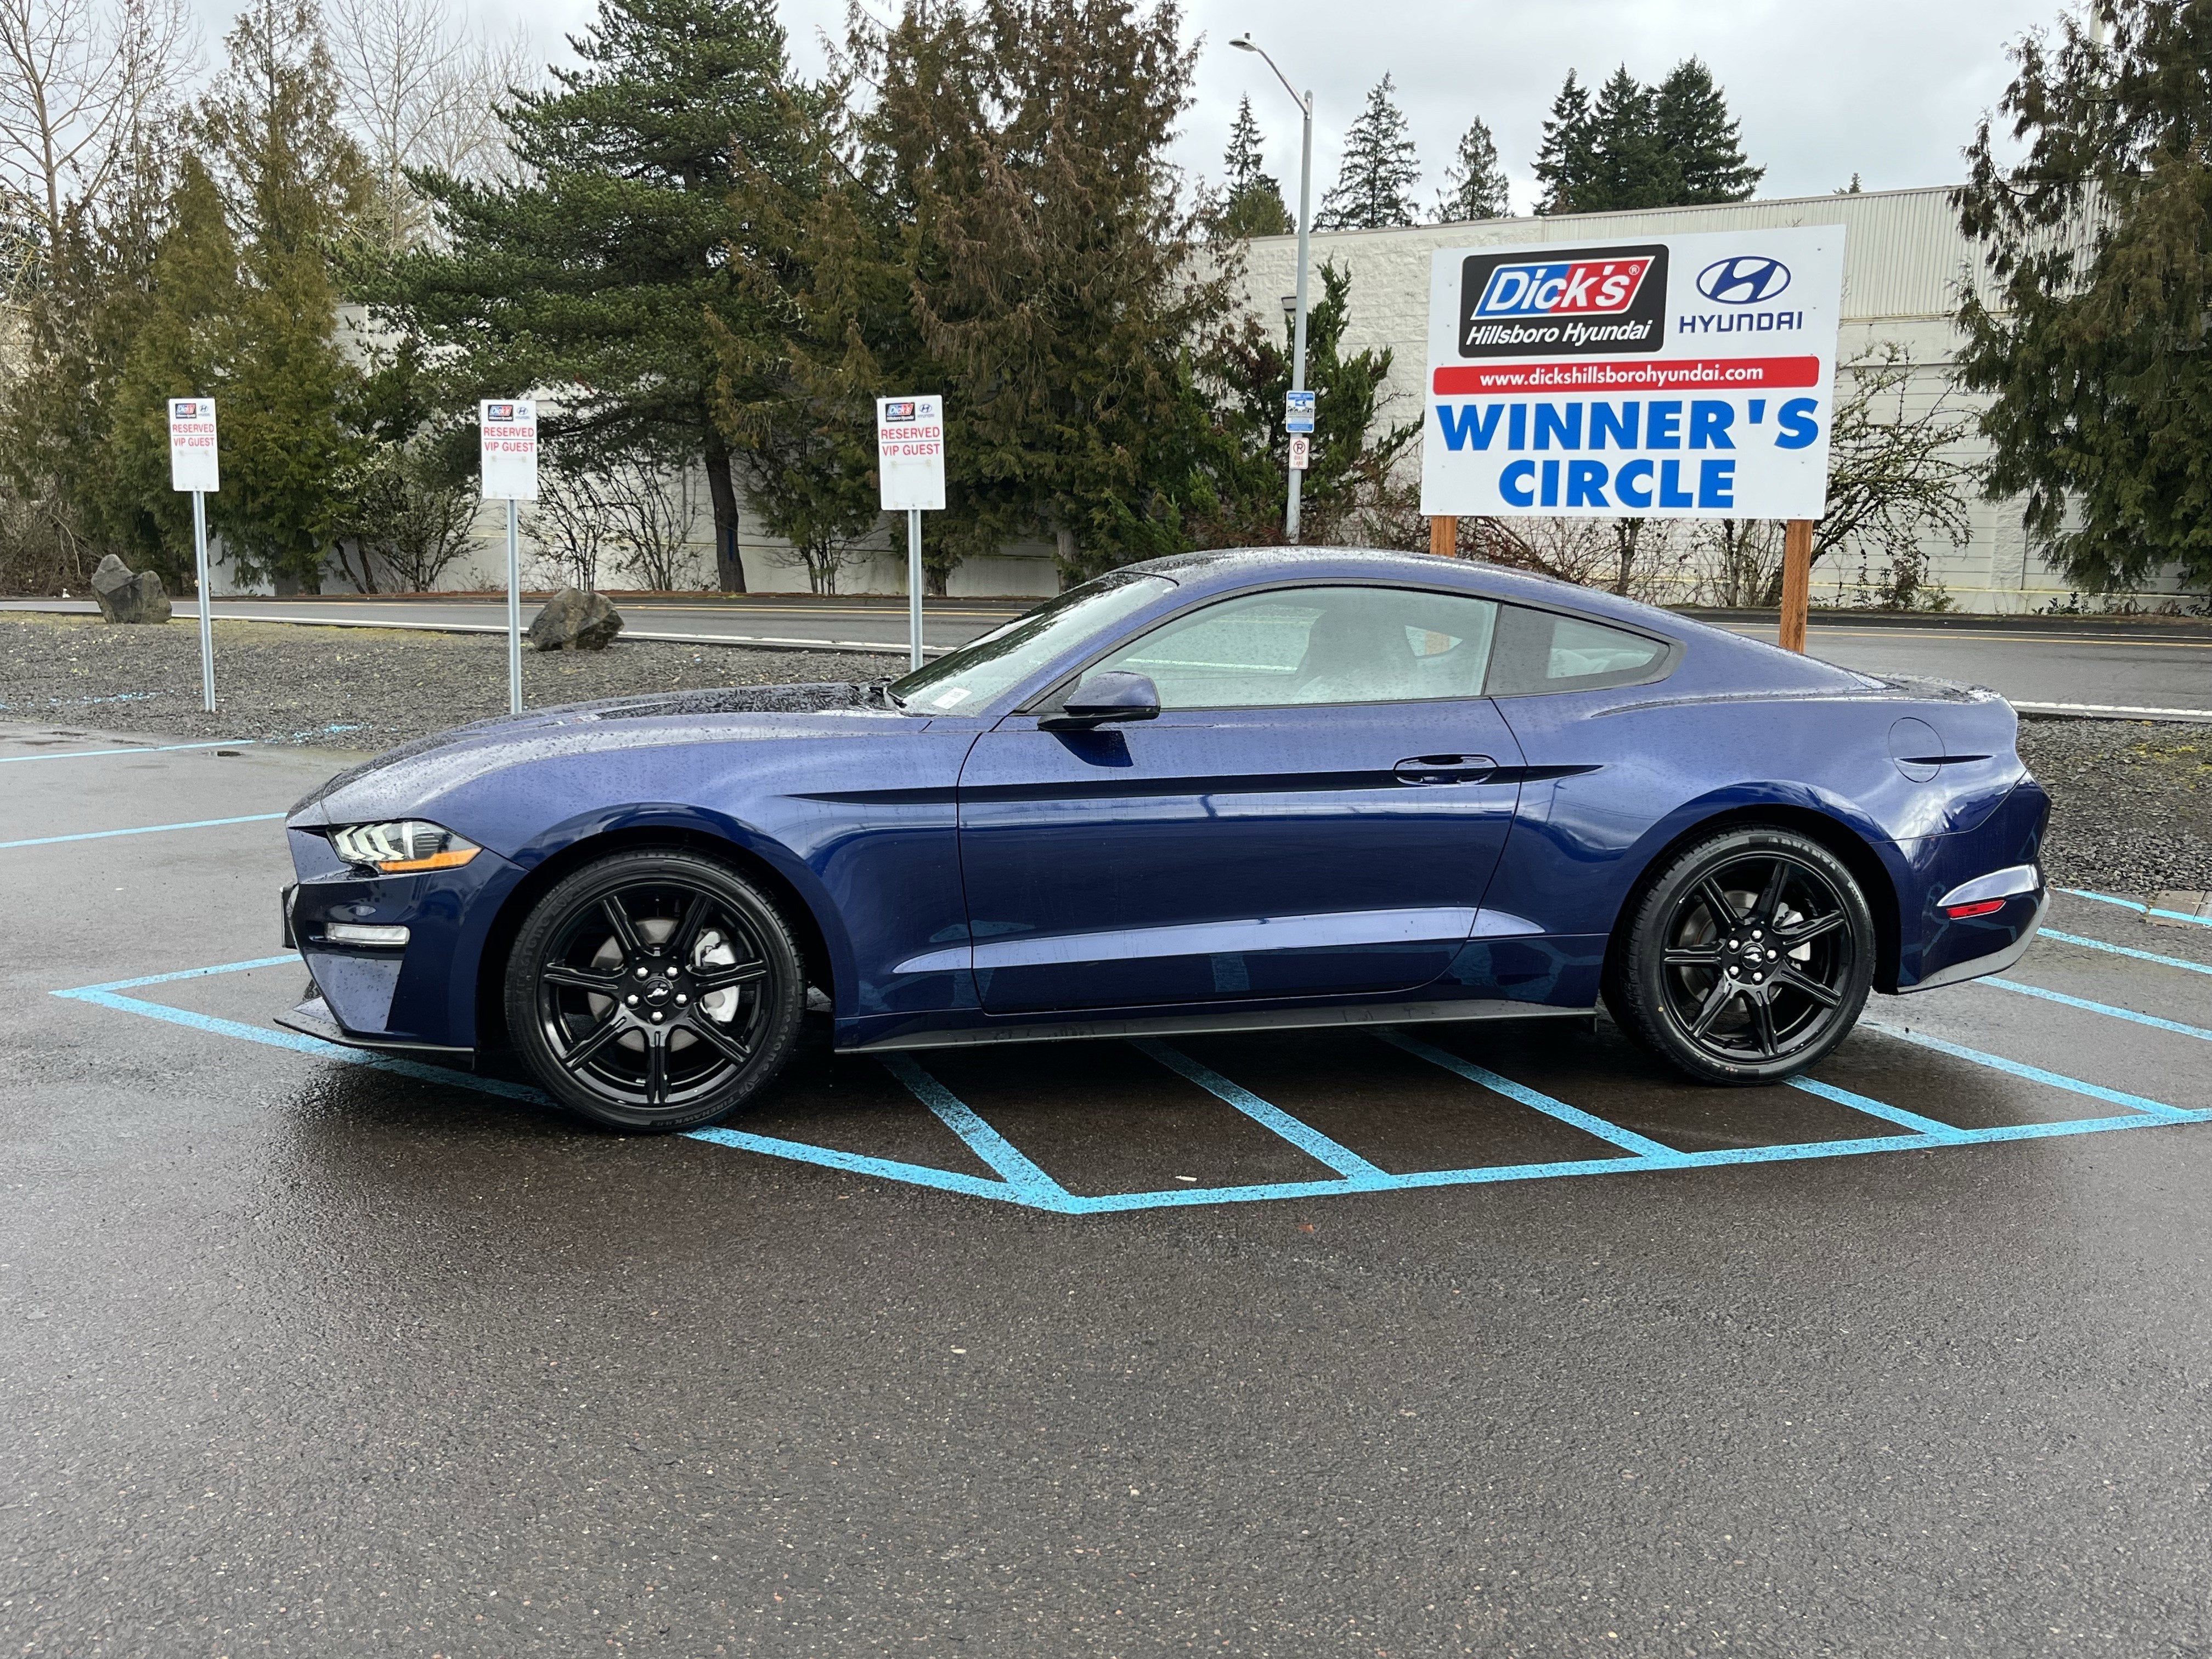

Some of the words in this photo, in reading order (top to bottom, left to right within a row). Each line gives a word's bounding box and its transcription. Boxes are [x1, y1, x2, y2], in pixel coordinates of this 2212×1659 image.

[1679, 311, 1803, 334] HYUNDAI
[1465, 325, 1560, 346] Hillsboro
[1561, 319, 1653, 347] Hyundai
[1480, 364, 1764, 387] www.dickshillsborohyundai.com
[172, 424, 214, 433] RESERVED
[1436, 397, 1819, 450] WINNER'S
[484, 427, 534, 437] RESERVED
[881, 427, 940, 439] RESERVED
[174, 437, 185, 447] VIP
[188, 438, 215, 447] GUEST
[484, 442, 499, 452] VIP
[502, 442, 534, 452] GUEST
[882, 445, 899, 456] VIP
[902, 444, 940, 455] GUEST
[1498, 459, 1736, 508] CIRCLE
